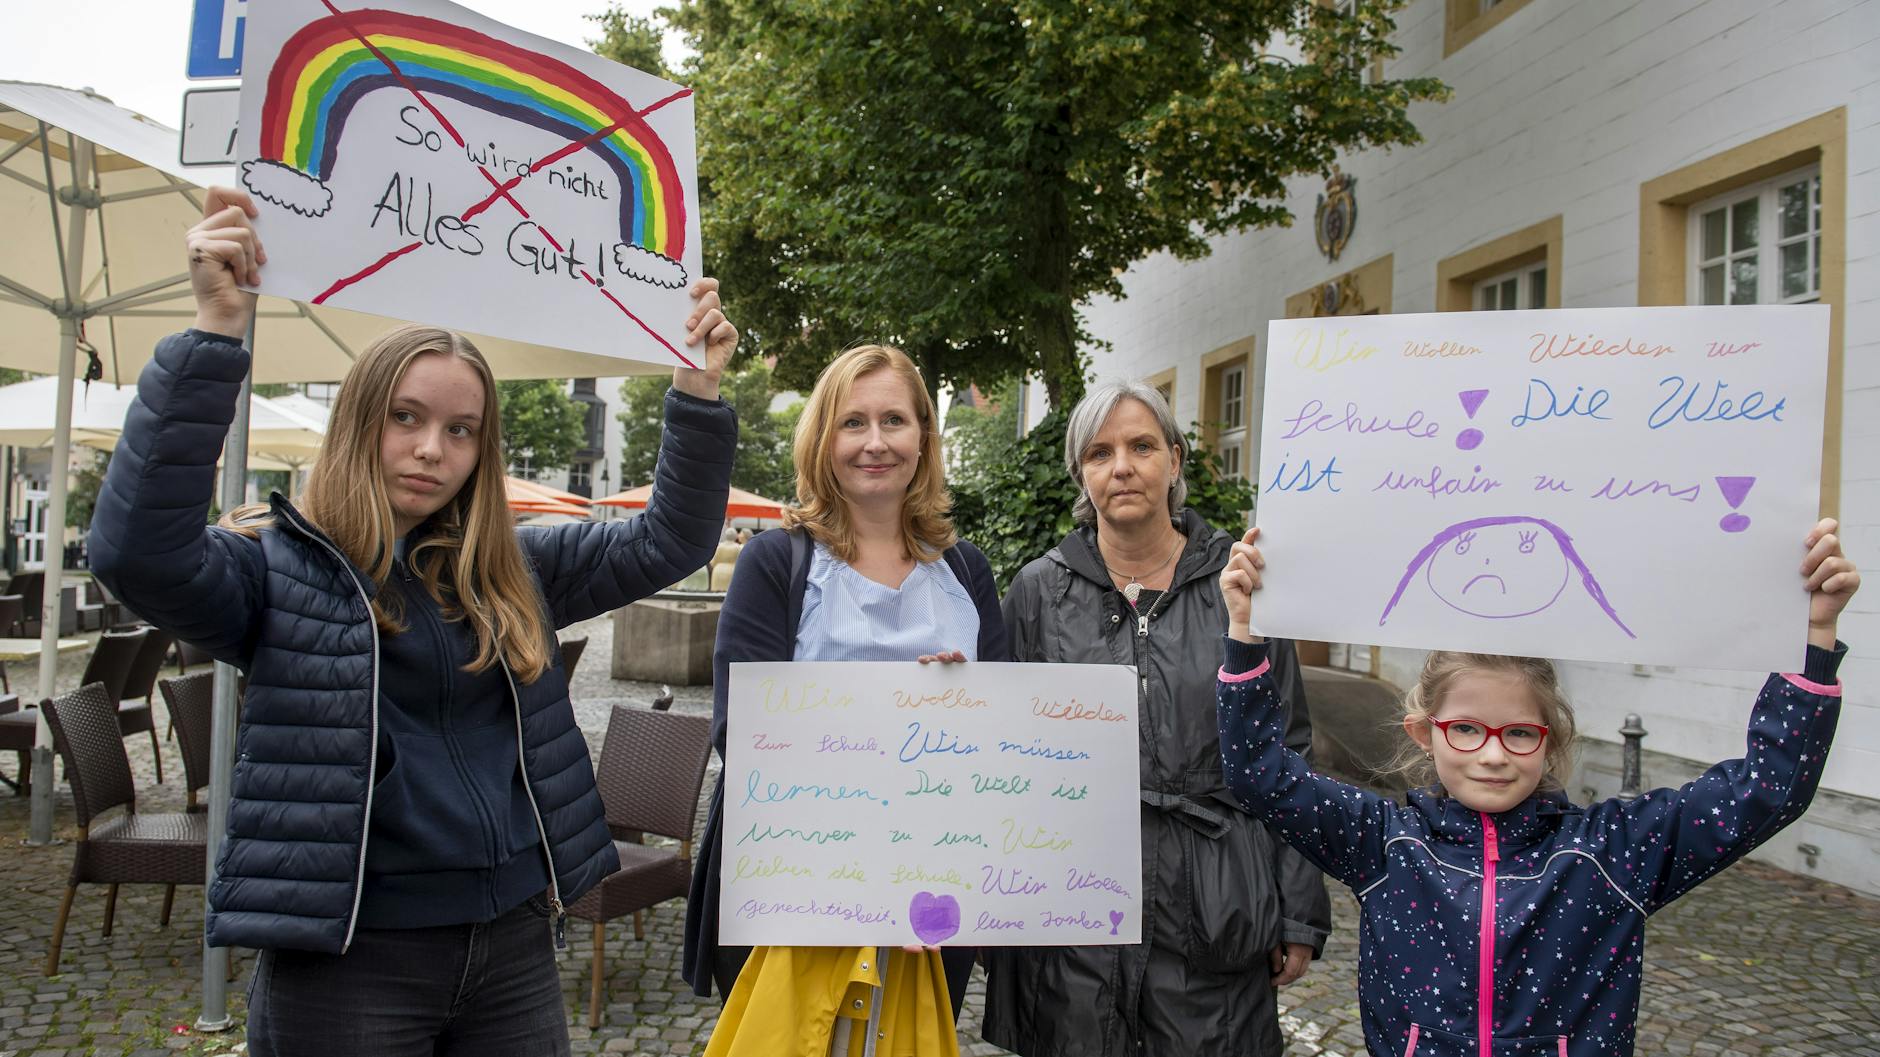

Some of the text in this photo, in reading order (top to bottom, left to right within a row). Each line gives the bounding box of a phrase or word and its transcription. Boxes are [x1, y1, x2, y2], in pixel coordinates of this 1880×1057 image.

[396, 105, 609, 200] So wird nicht
[370, 172, 484, 256] Alles
[1511, 378, 1612, 429] Die
[1648, 376, 1786, 430] Welt
[1265, 453, 1343, 493] ist
[1051, 778, 1089, 801] ist
[981, 864, 1047, 896] Wir
